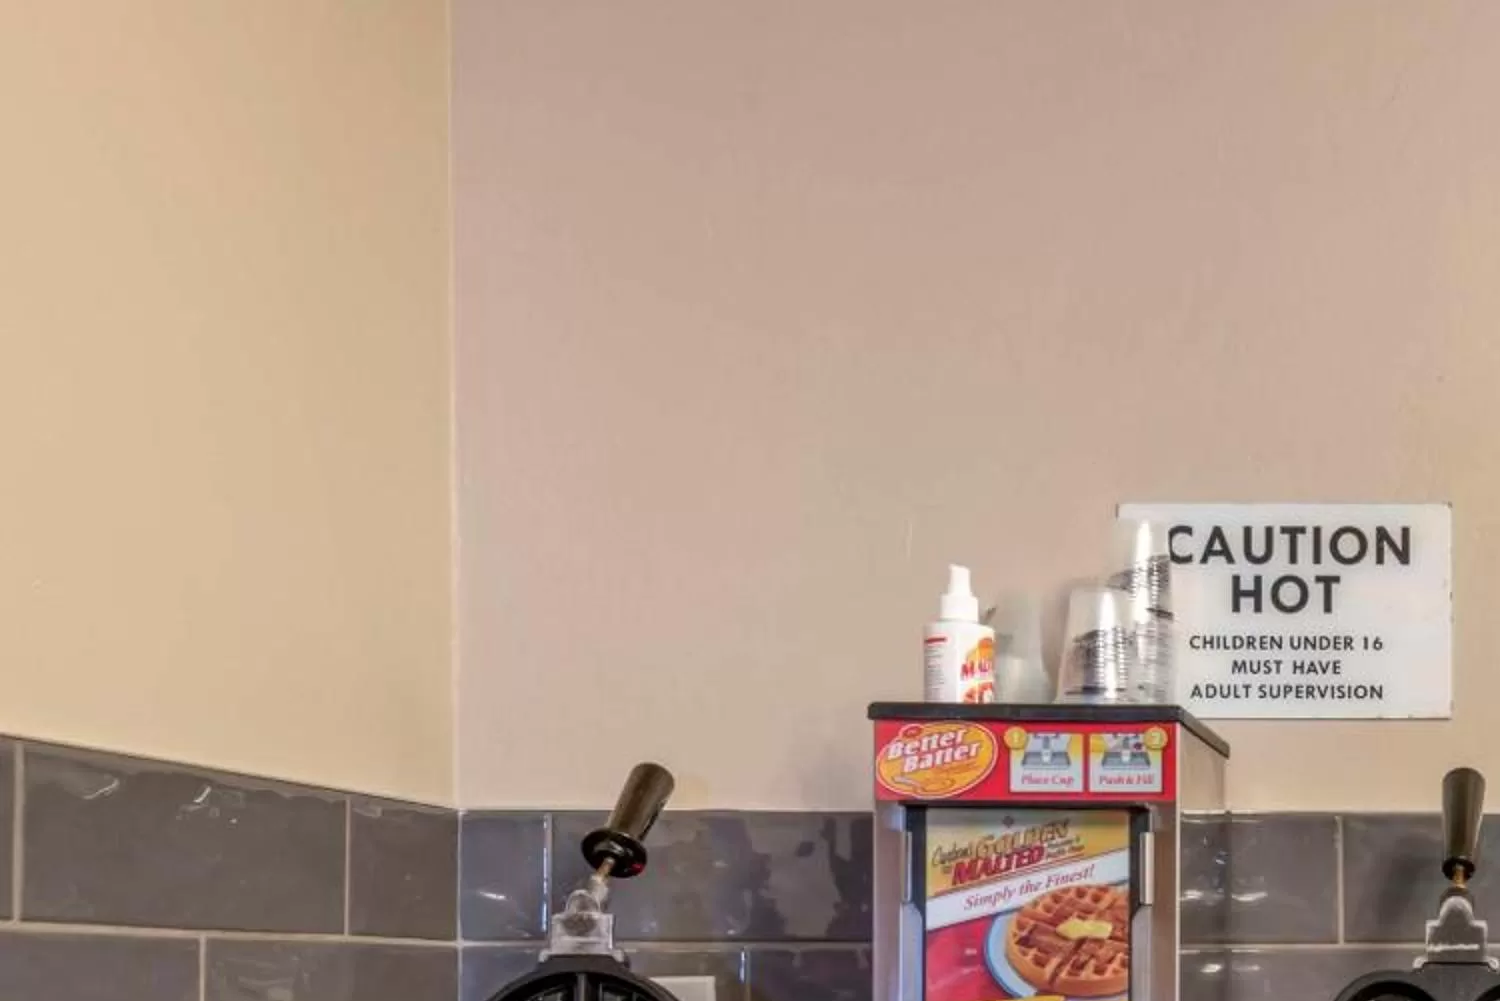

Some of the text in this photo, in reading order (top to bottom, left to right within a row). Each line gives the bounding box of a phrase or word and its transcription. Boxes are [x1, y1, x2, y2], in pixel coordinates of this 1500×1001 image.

[1168, 525, 1411, 566] CAUTION
[1231, 574, 1341, 614] HOT
[1189, 635, 1384, 651] CHILDREN UNDER 16
[1231, 660, 1342, 675] MUST HAVE
[1190, 684, 1384, 700] ADULT SUPERVISION
[887, 728, 968, 761] Better
[903, 742, 982, 774] Batter
[952, 842, 1046, 886] MALTED
[963, 884, 1017, 911] Simply
[1019, 879, 1042, 896] the
